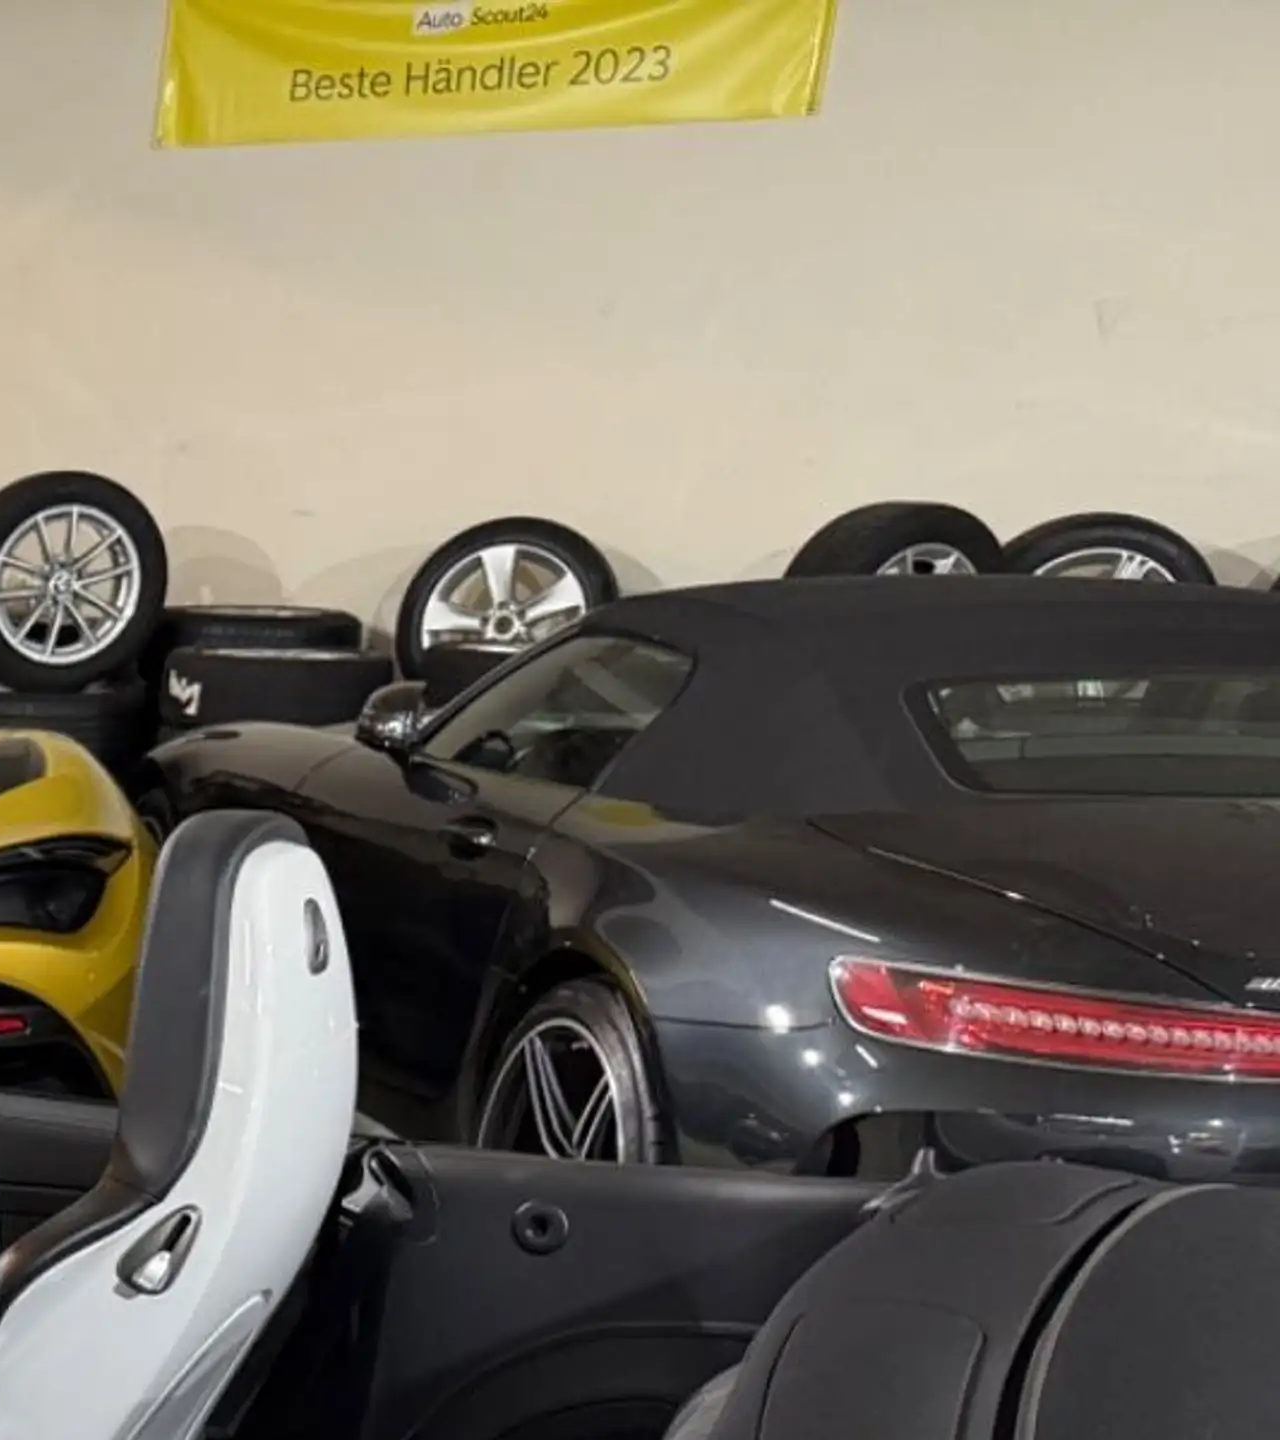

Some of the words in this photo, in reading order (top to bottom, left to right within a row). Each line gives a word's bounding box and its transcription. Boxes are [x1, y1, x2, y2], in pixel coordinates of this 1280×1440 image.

[416, 9, 463, 31] Auto
[290, 66, 392, 101] Beste
[403, 52, 558, 96] Händler
[568, 45, 672, 86] 2023
